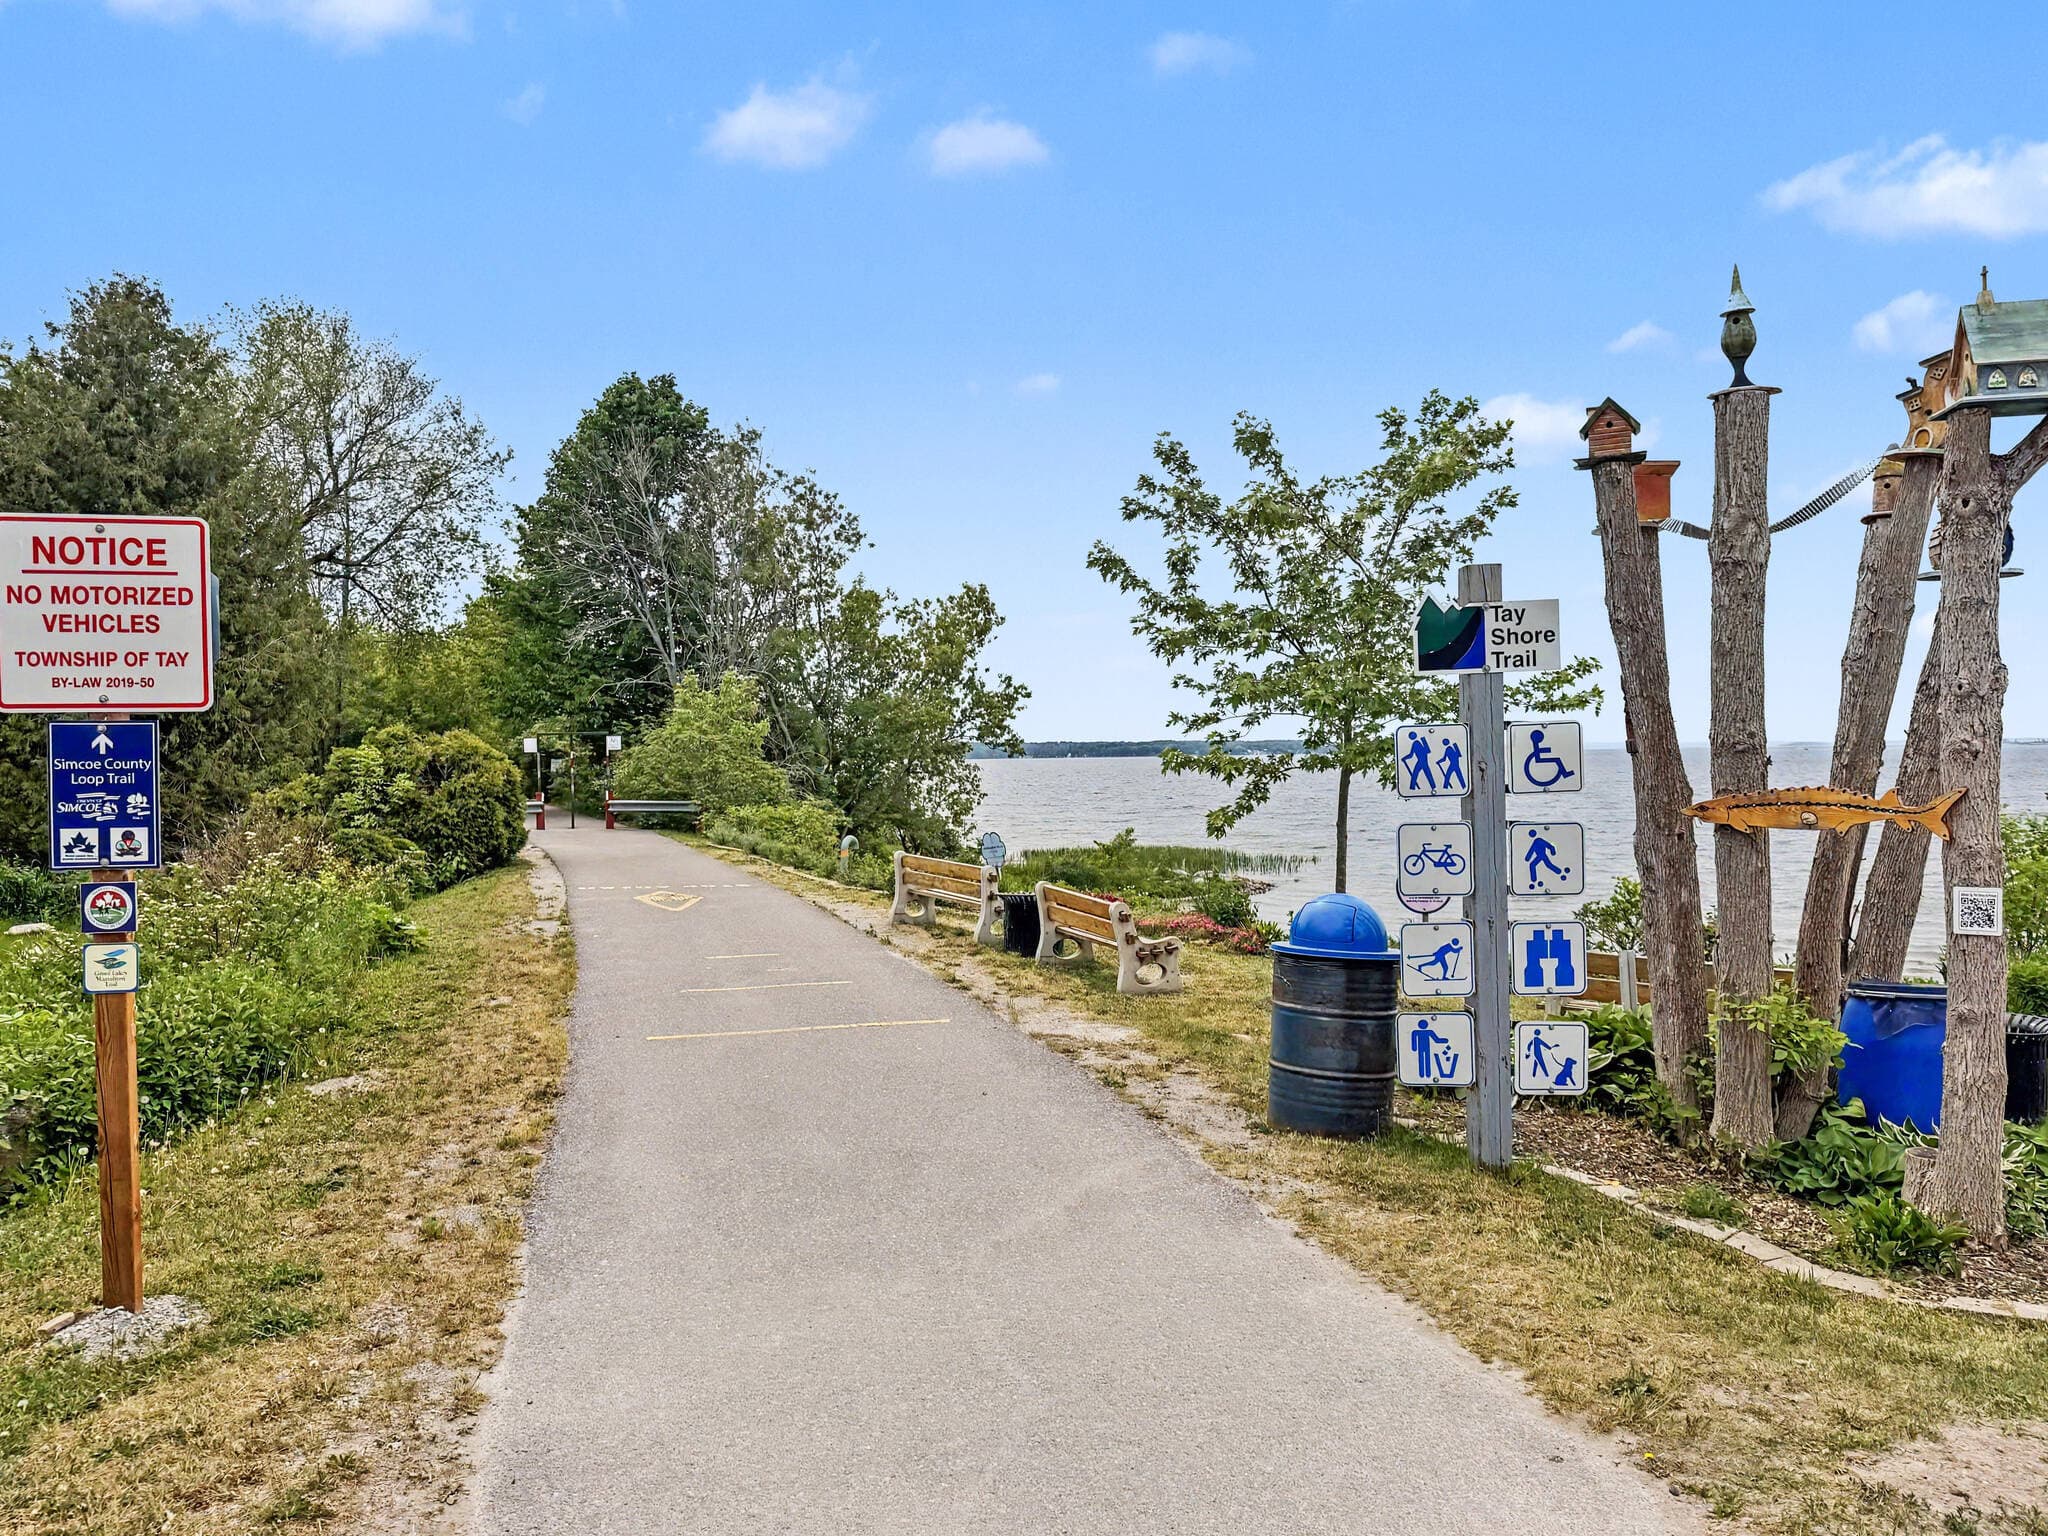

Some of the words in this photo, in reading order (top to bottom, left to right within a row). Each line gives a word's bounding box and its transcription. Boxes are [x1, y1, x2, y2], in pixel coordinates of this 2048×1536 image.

[32, 536, 167, 566] NOTICE
[6, 585, 42, 605] NO
[51, 585, 194, 606] MOTORIZED
[41, 614, 161, 634] VEHICLES
[1489, 605, 1526, 626] Tay
[1491, 628, 1556, 645] Shore
[14, 651, 118, 667] TOWNSHIP
[124, 652, 150, 667] OF
[155, 652, 190, 667] TAY
[1491, 649, 1537, 668] Trail
[51, 677, 103, 688] BY-LAW
[106, 677, 155, 688] 2019-50
[54, 758, 102, 770] Simcoe
[104, 758, 152, 772] County
[71, 773, 105, 787] Loop
[106, 772, 135, 784] Trail
[56, 801, 103, 814] SIMCOE
